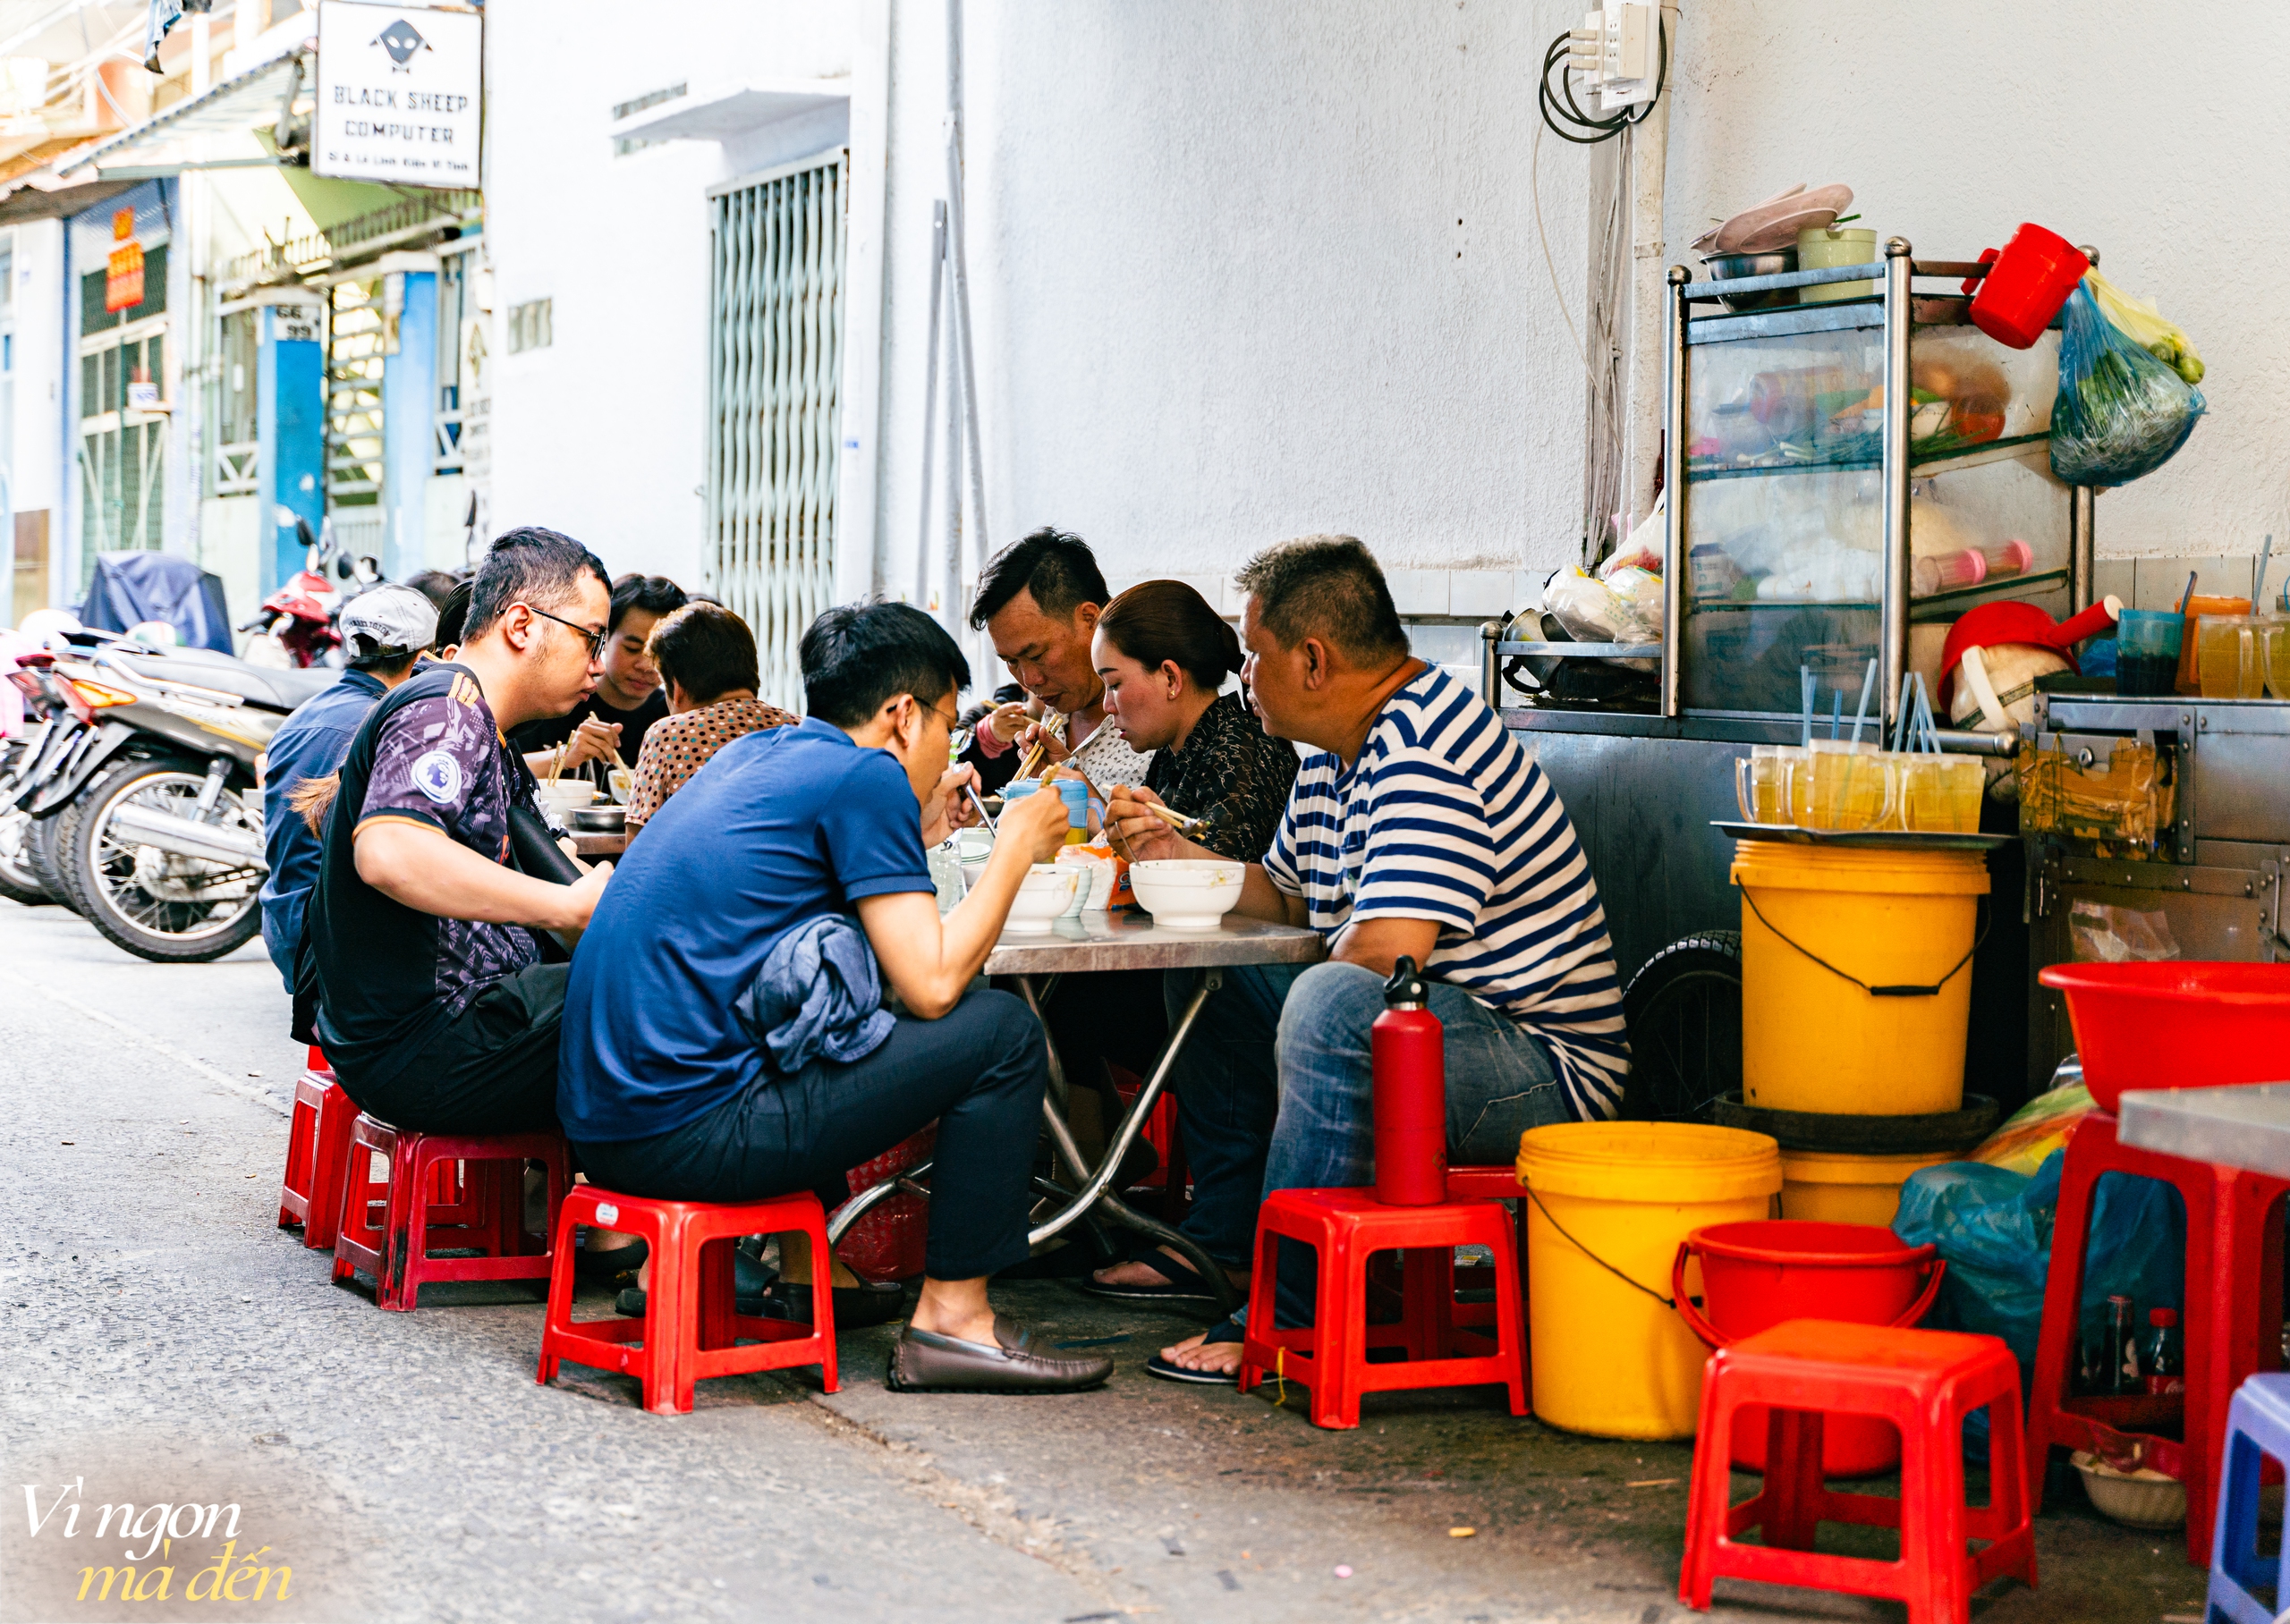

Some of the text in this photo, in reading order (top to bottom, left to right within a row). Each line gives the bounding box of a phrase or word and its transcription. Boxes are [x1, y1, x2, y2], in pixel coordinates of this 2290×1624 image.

[335, 85, 469, 114] BLACK SHEEP
[346, 121, 454, 143] COMPUTER
